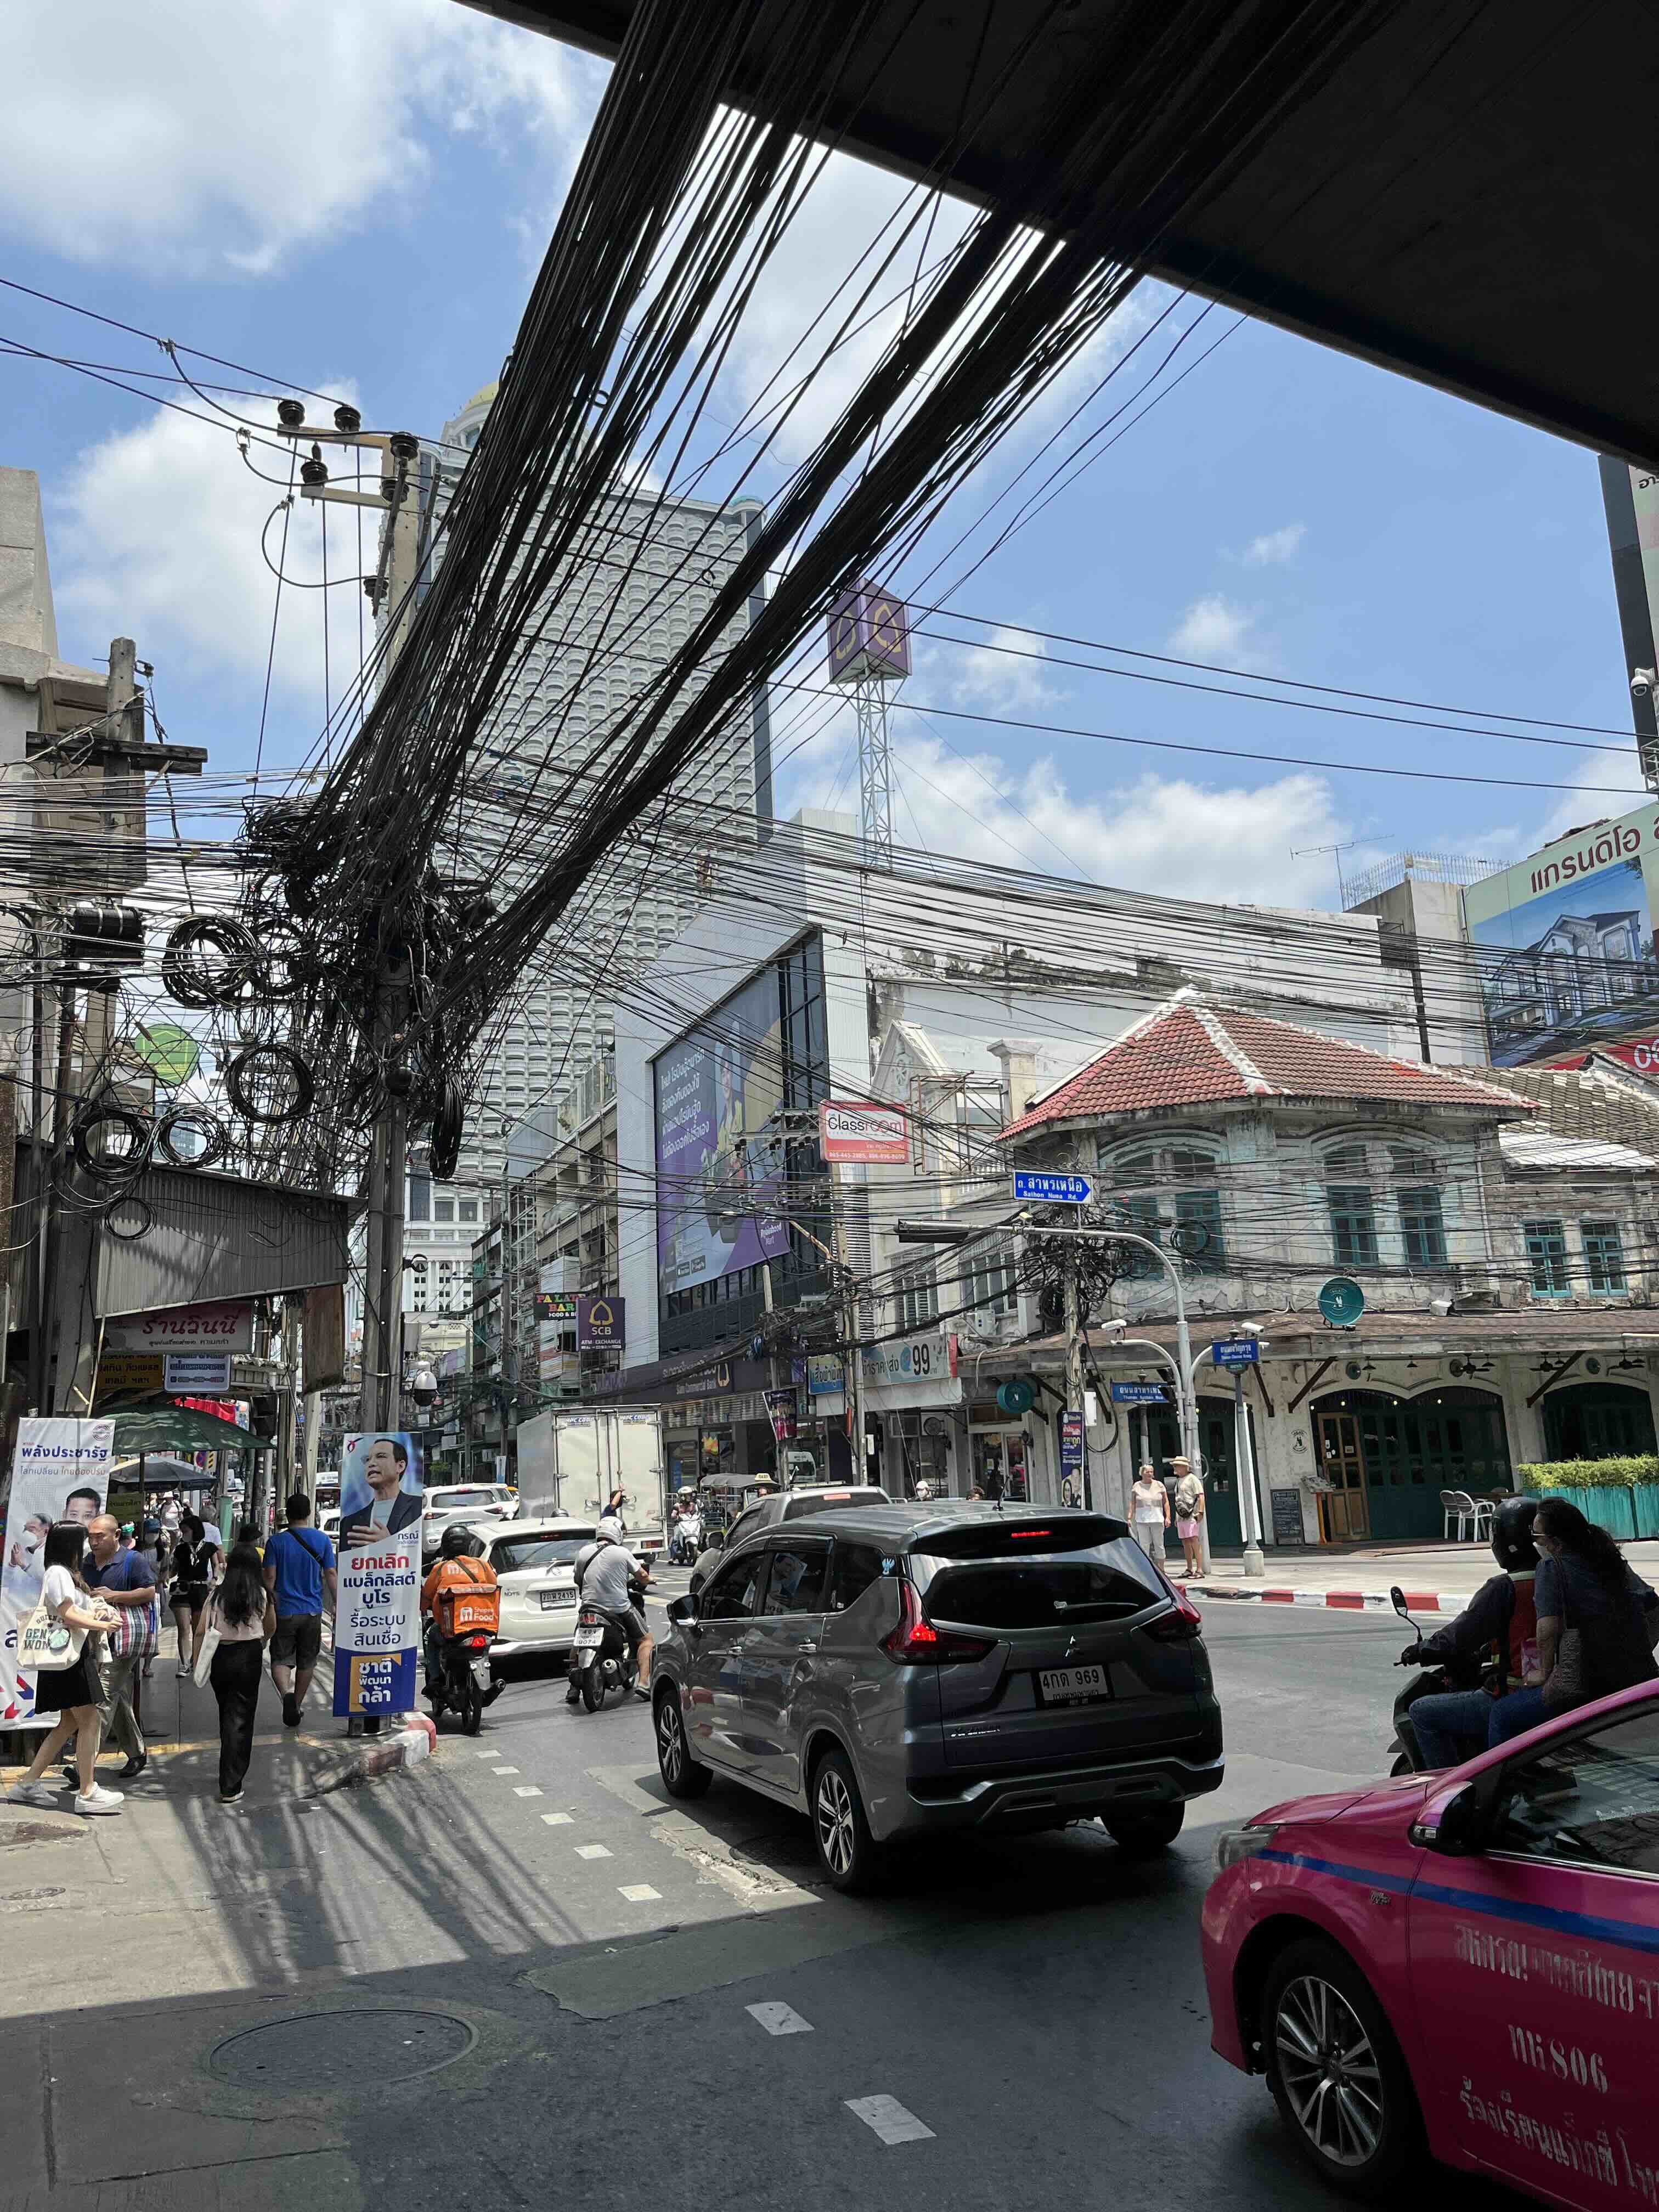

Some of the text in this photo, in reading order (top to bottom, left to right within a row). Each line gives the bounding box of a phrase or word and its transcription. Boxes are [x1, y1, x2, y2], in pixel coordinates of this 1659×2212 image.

[1531, 825, 1641, 893] แกรนดิโอ
[1018, 1177, 1082, 1192] ถ. สาทรเหนือ
[549, 1303, 575, 1312] BAR
[591, 1327, 612, 1335] SCB
[912, 1344, 931, 1375] 99
[22, 1444, 108, 1462] พลังประชารัฐ
[21, 1465, 106, 1475] โลกเปลี่ยน ไทยต้องปรับ
[398, 1530, 419, 1540] กรณ์
[351, 1553, 409, 1571] ยกเลิก
[343, 1571, 417, 1588] แบล็กลิสต์
[362, 1590, 391, 1609] บูโร
[351, 1608, 406, 1628] รื้อระบบ
[473, 1612, 494, 1622] Food
[354, 1627, 401, 1646] สินเชื่อ
[358, 1657, 392, 1674] ชาติ
[359, 1675, 392, 1686] พัฒนา
[1075, 1668, 1099, 1685] 969
[358, 1686, 392, 1705] กล้า
[1549, 2038, 1609, 2094] 806
